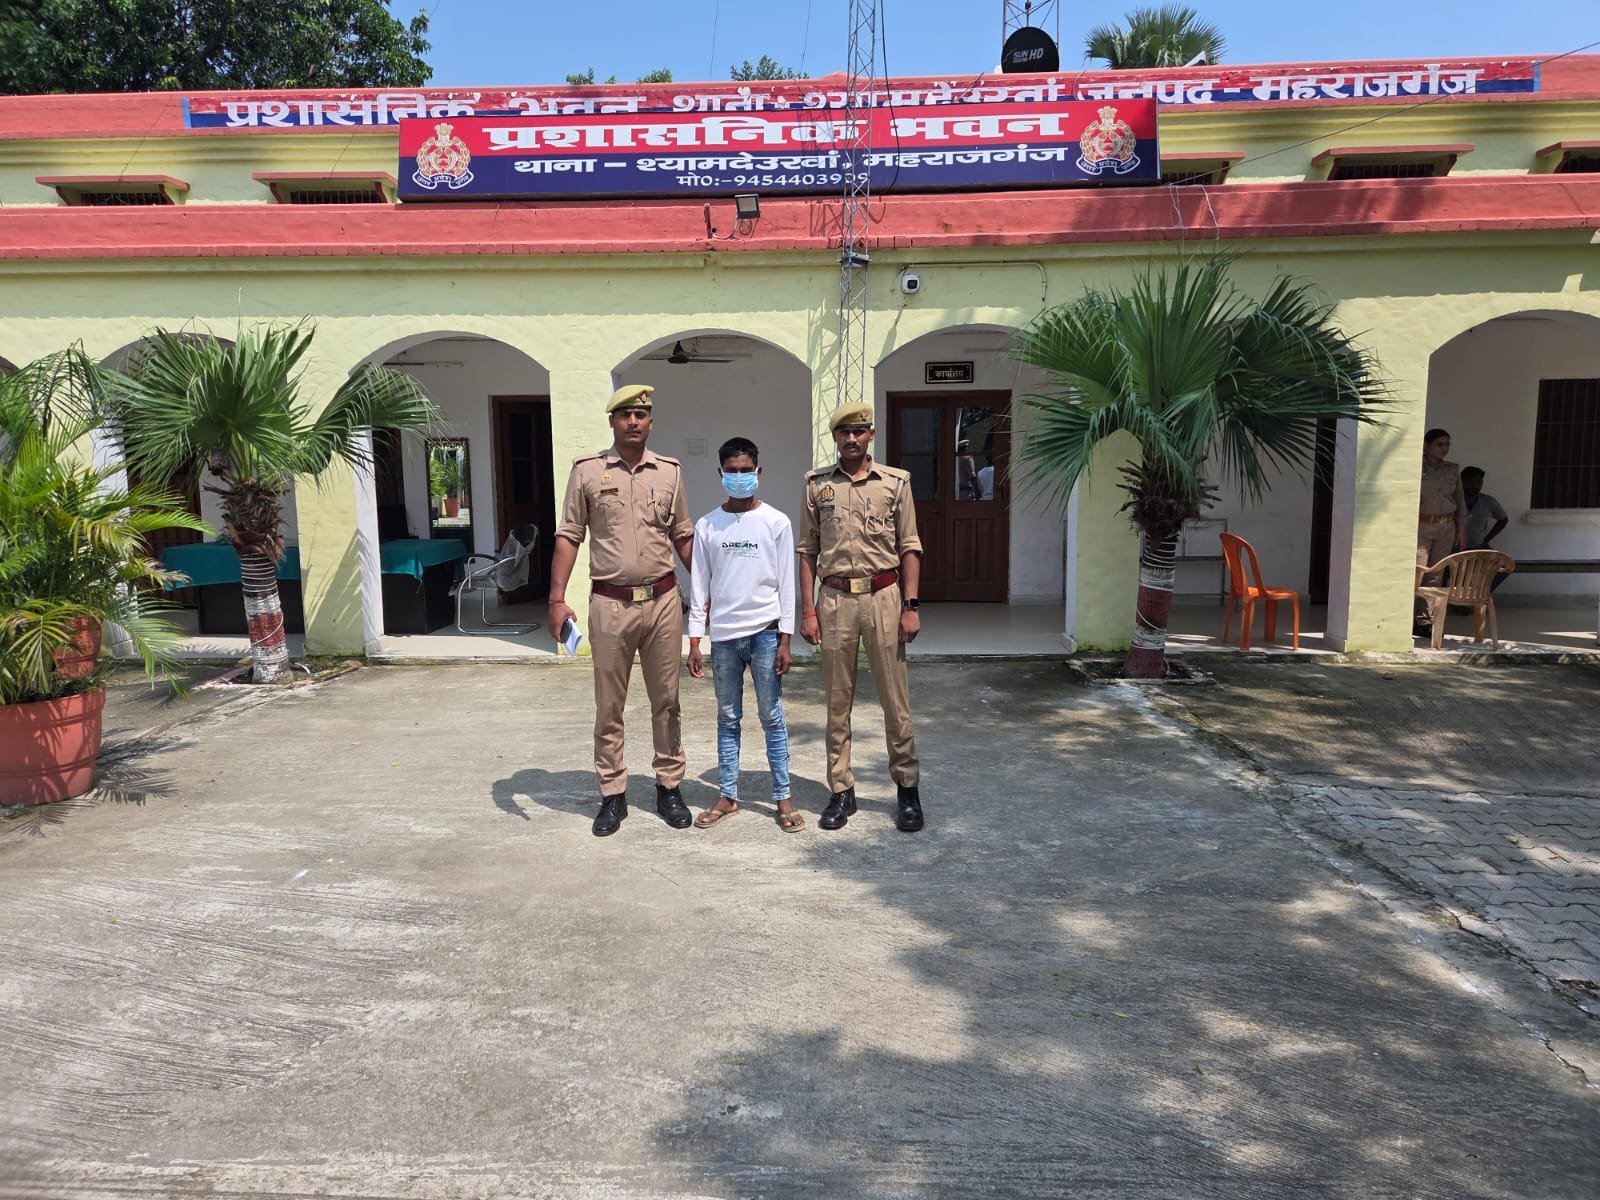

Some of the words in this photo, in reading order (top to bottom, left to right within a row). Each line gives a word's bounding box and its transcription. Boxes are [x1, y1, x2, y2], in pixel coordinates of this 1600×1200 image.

[1029, 48, 1044, 60] HD
[220, 93, 482, 126] प्रशासनिक
[1252, 64, 1485, 101] महराजगंज
[482, 117, 867, 149] प्रशासनिक
[890, 113, 1070, 139] भवन
[513, 158, 597, 174] थाना
[862, 144, 1068, 168] महराजगंज
[721, 541, 758, 549] DREAM
